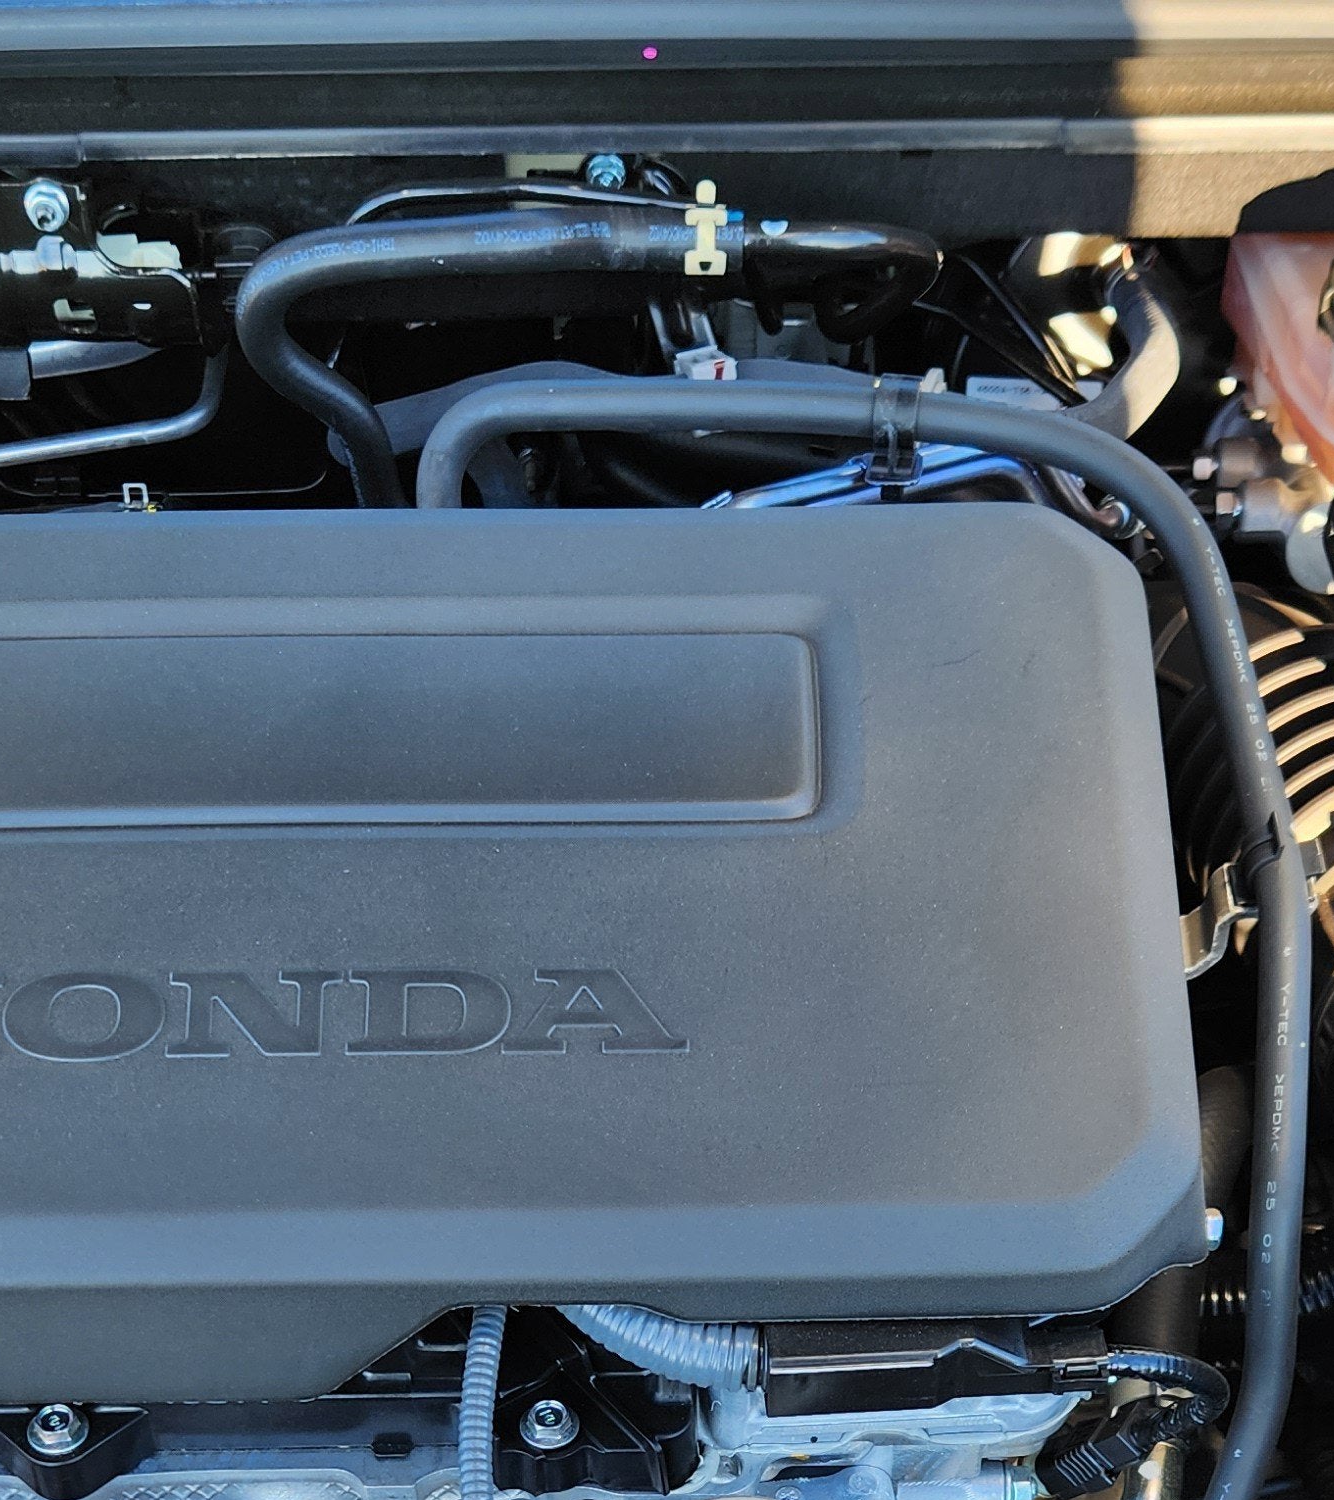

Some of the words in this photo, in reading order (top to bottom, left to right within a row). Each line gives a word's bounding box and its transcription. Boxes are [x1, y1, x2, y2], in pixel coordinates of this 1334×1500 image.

[1204, 548, 1227, 597] Y-TEC
[1276, 981, 1292, 1047] Y-TEC
[1270, 1073, 1285, 1152] >EPDM<
[1265, 1180, 1277, 1212] 25
[1261, 1233, 1272, 1265] 02
